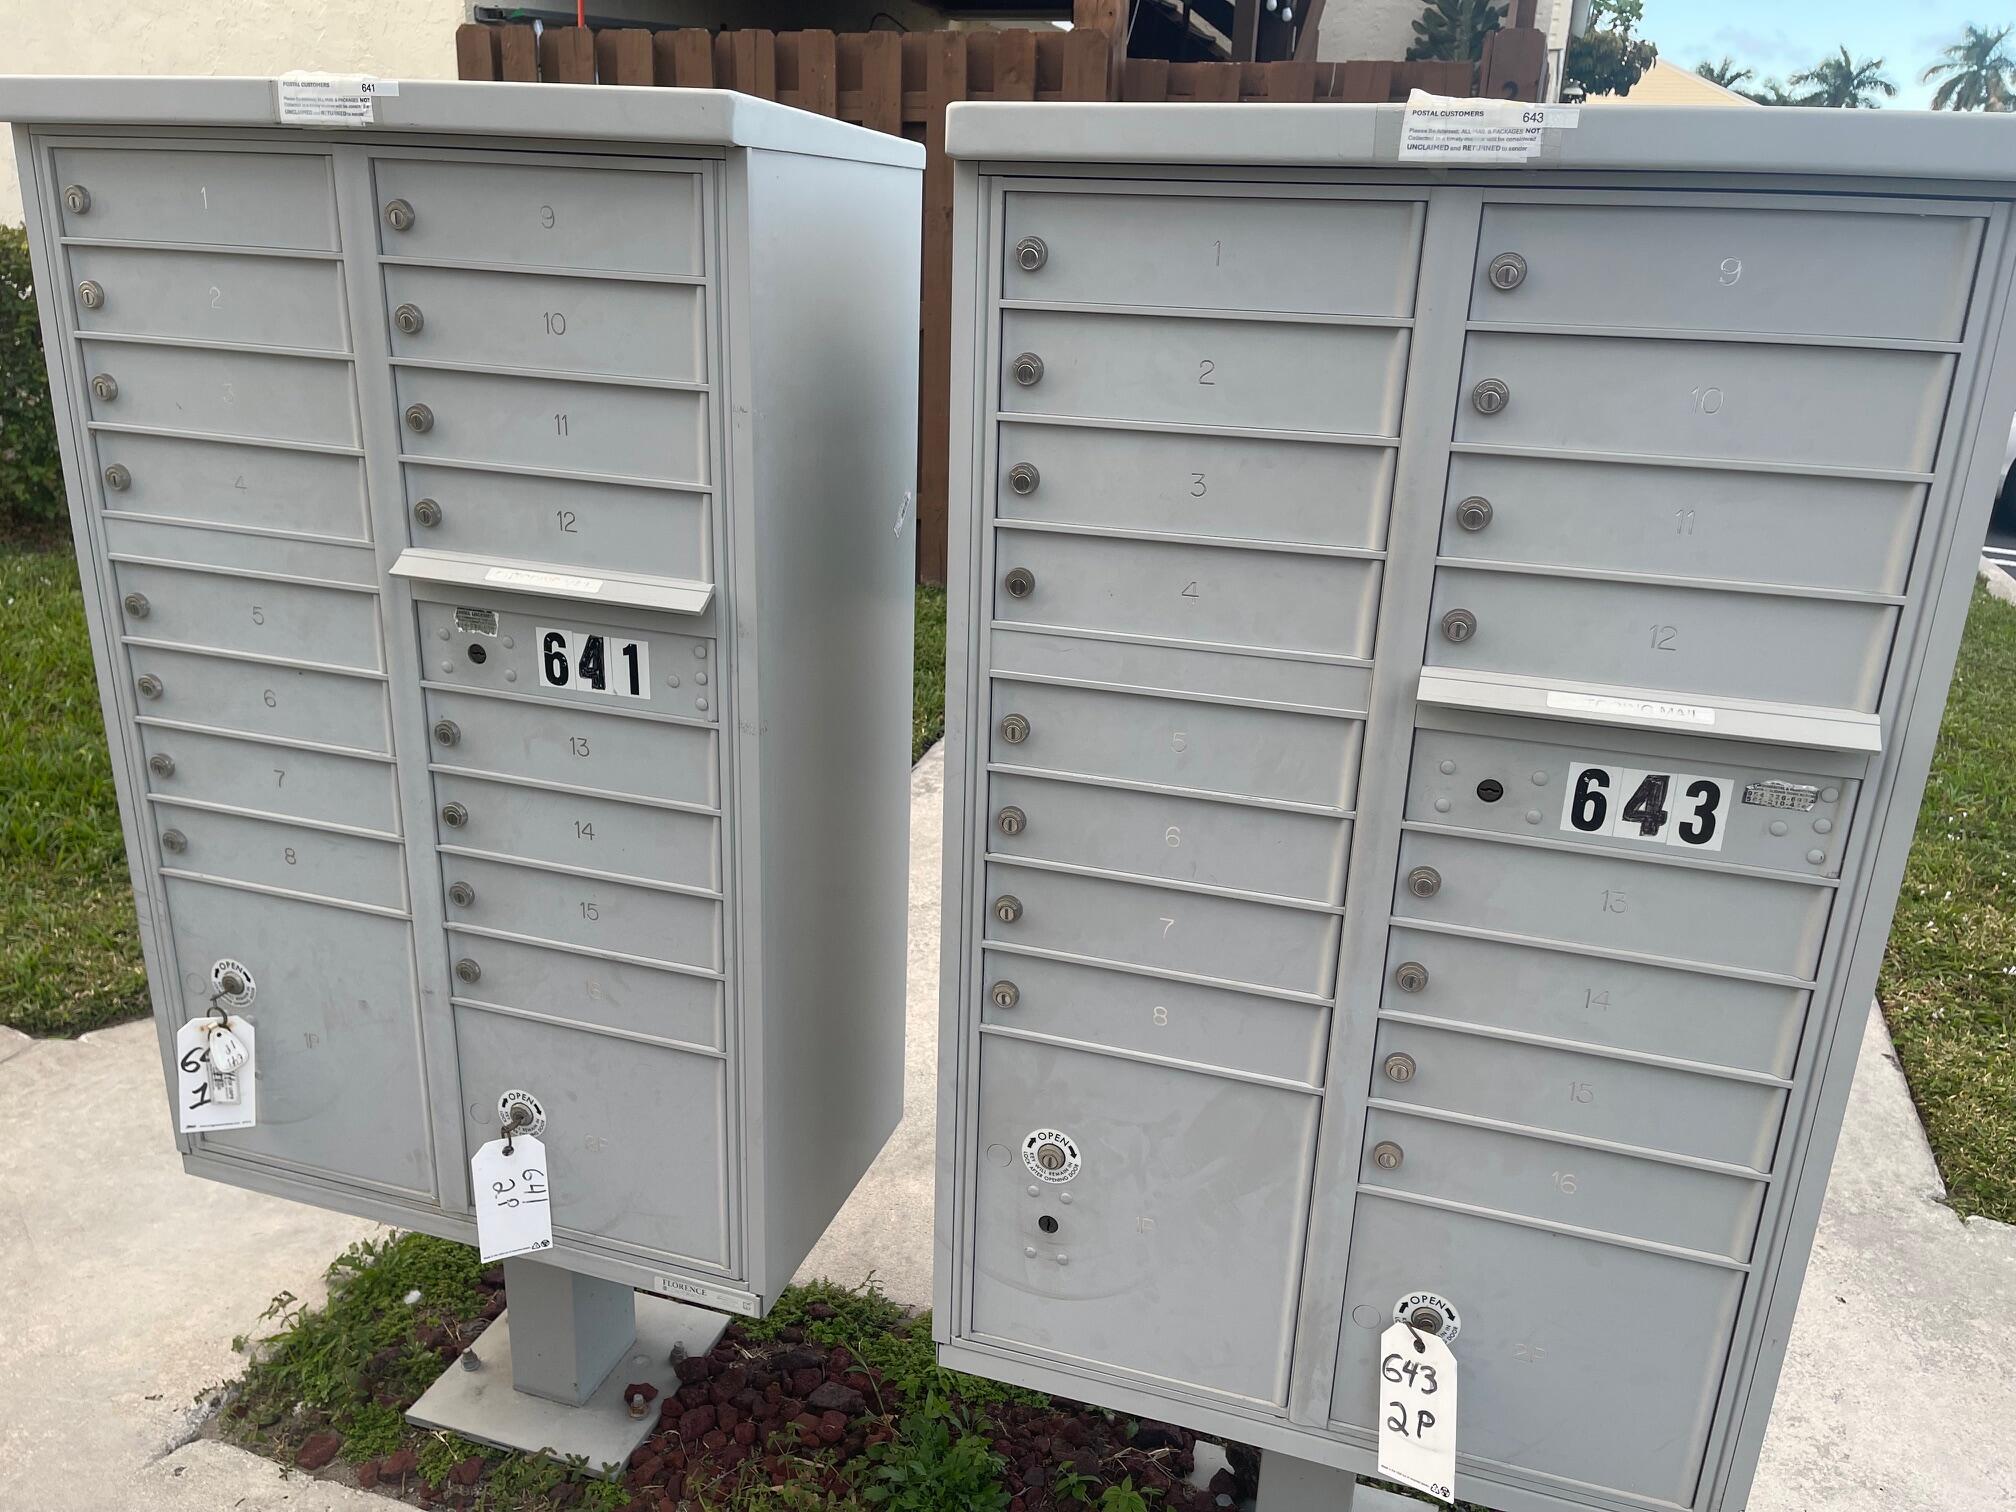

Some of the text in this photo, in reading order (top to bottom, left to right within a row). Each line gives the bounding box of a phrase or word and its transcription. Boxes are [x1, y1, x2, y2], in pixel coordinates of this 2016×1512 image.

[361, 83, 375, 93] 641
[1522, 112, 1544, 123] 643
[1406, 143, 1450, 151] UNCLAIMED
[200, 184, 208, 211] 1
[540, 205, 555, 230] 9
[1213, 239, 1222, 268] 1
[1719, 256, 1741, 287] 9
[209, 285, 223, 309] 2
[543, 312, 567, 336] 10
[1198, 359, 1216, 386] 2
[1689, 385, 1724, 415] 10
[554, 413, 569, 436] 11
[232, 474, 248, 496] 4
[1190, 472, 1208, 498] 3
[556, 510, 578, 534] 12
[1674, 508, 1697, 536] 11
[1180, 581, 1200, 608] 4
[250, 605, 265, 626] 5
[1648, 623, 1678, 652] 12
[543, 631, 640, 696] 641
[263, 688, 277, 708] 6
[569, 736, 590, 757] 13
[1171, 731, 1188, 754] 5
[272, 768, 286, 789] 7
[1570, 768, 1722, 846] 643
[574, 820, 595, 841] 14
[1165, 825, 1181, 849] 6
[284, 847, 297, 866] 8
[579, 901, 600, 921] 15
[1600, 888, 1629, 914] 13
[1159, 916, 1176, 941] 7
[219, 961, 243, 974] OPEN
[1584, 987, 1612, 1012] 14
[1152, 1005, 1168, 1027] 8
[508, 1092, 535, 1105] OPEN
[1568, 1080, 1594, 1104] 15
[1037, 1131, 1070, 1147] OPEN
[522, 1168, 549, 1204] 641
[1551, 1169, 1578, 1195] 16
[662, 1278, 708, 1297] FLORENCE
[1409, 1294, 1446, 1310] OPEN
[1382, 1353, 1438, 1395] 643
